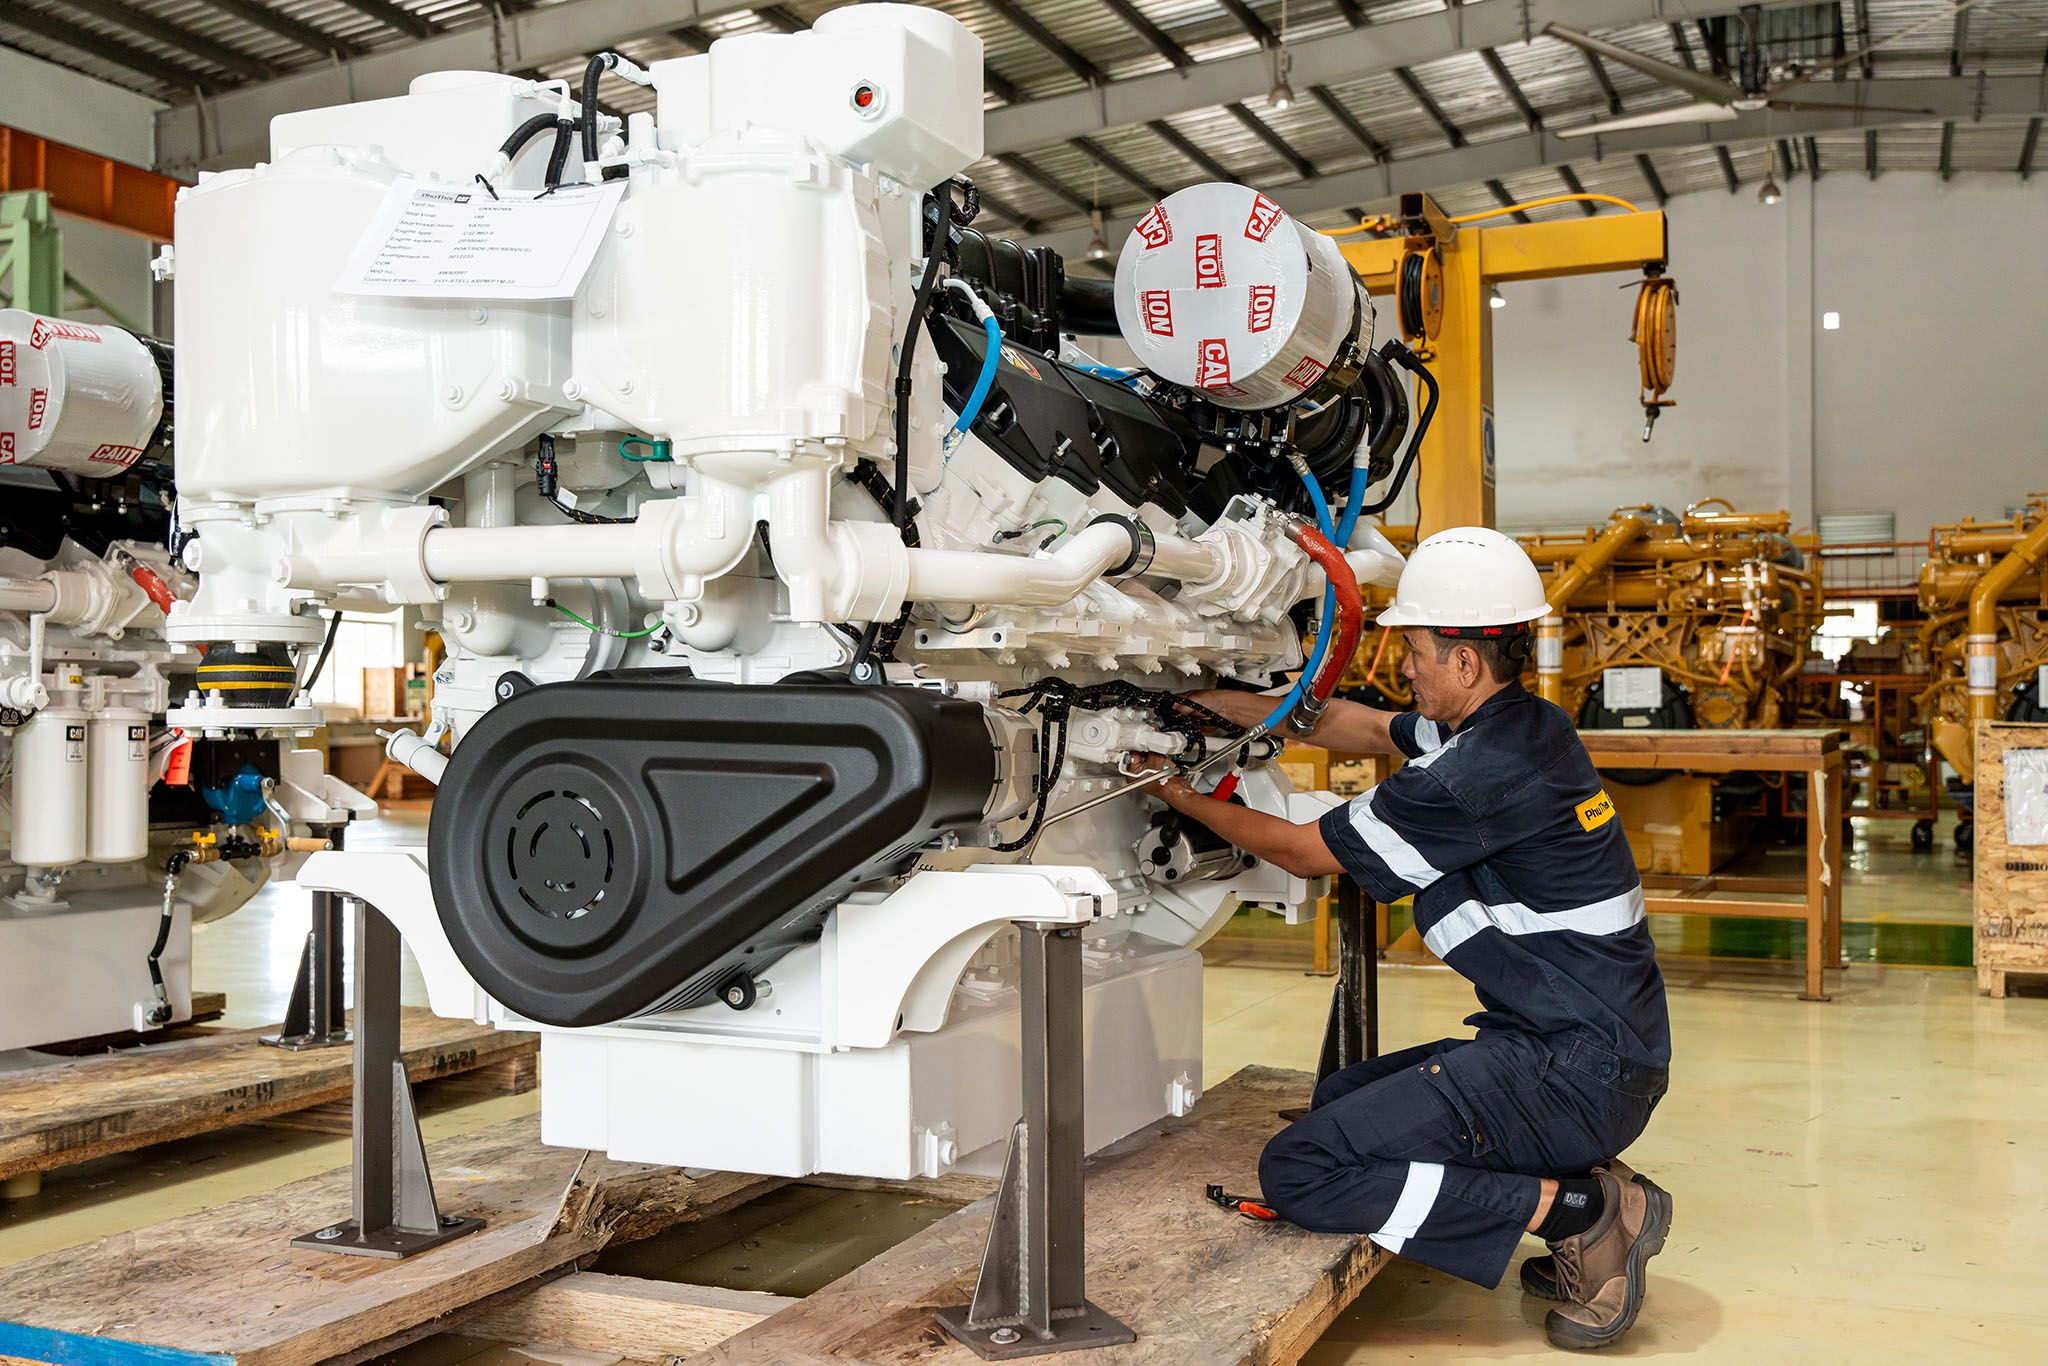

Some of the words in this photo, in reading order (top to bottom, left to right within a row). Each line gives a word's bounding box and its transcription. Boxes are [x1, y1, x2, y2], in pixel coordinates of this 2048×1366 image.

[1197, 237, 1221, 288] ION
[1147, 291, 1172, 333] ION
[1252, 286, 1274, 329] ION
[69, 729, 83, 740] CAT
[131, 728, 145, 739] CAT
[1564, 1191, 1588, 1206] D&G
